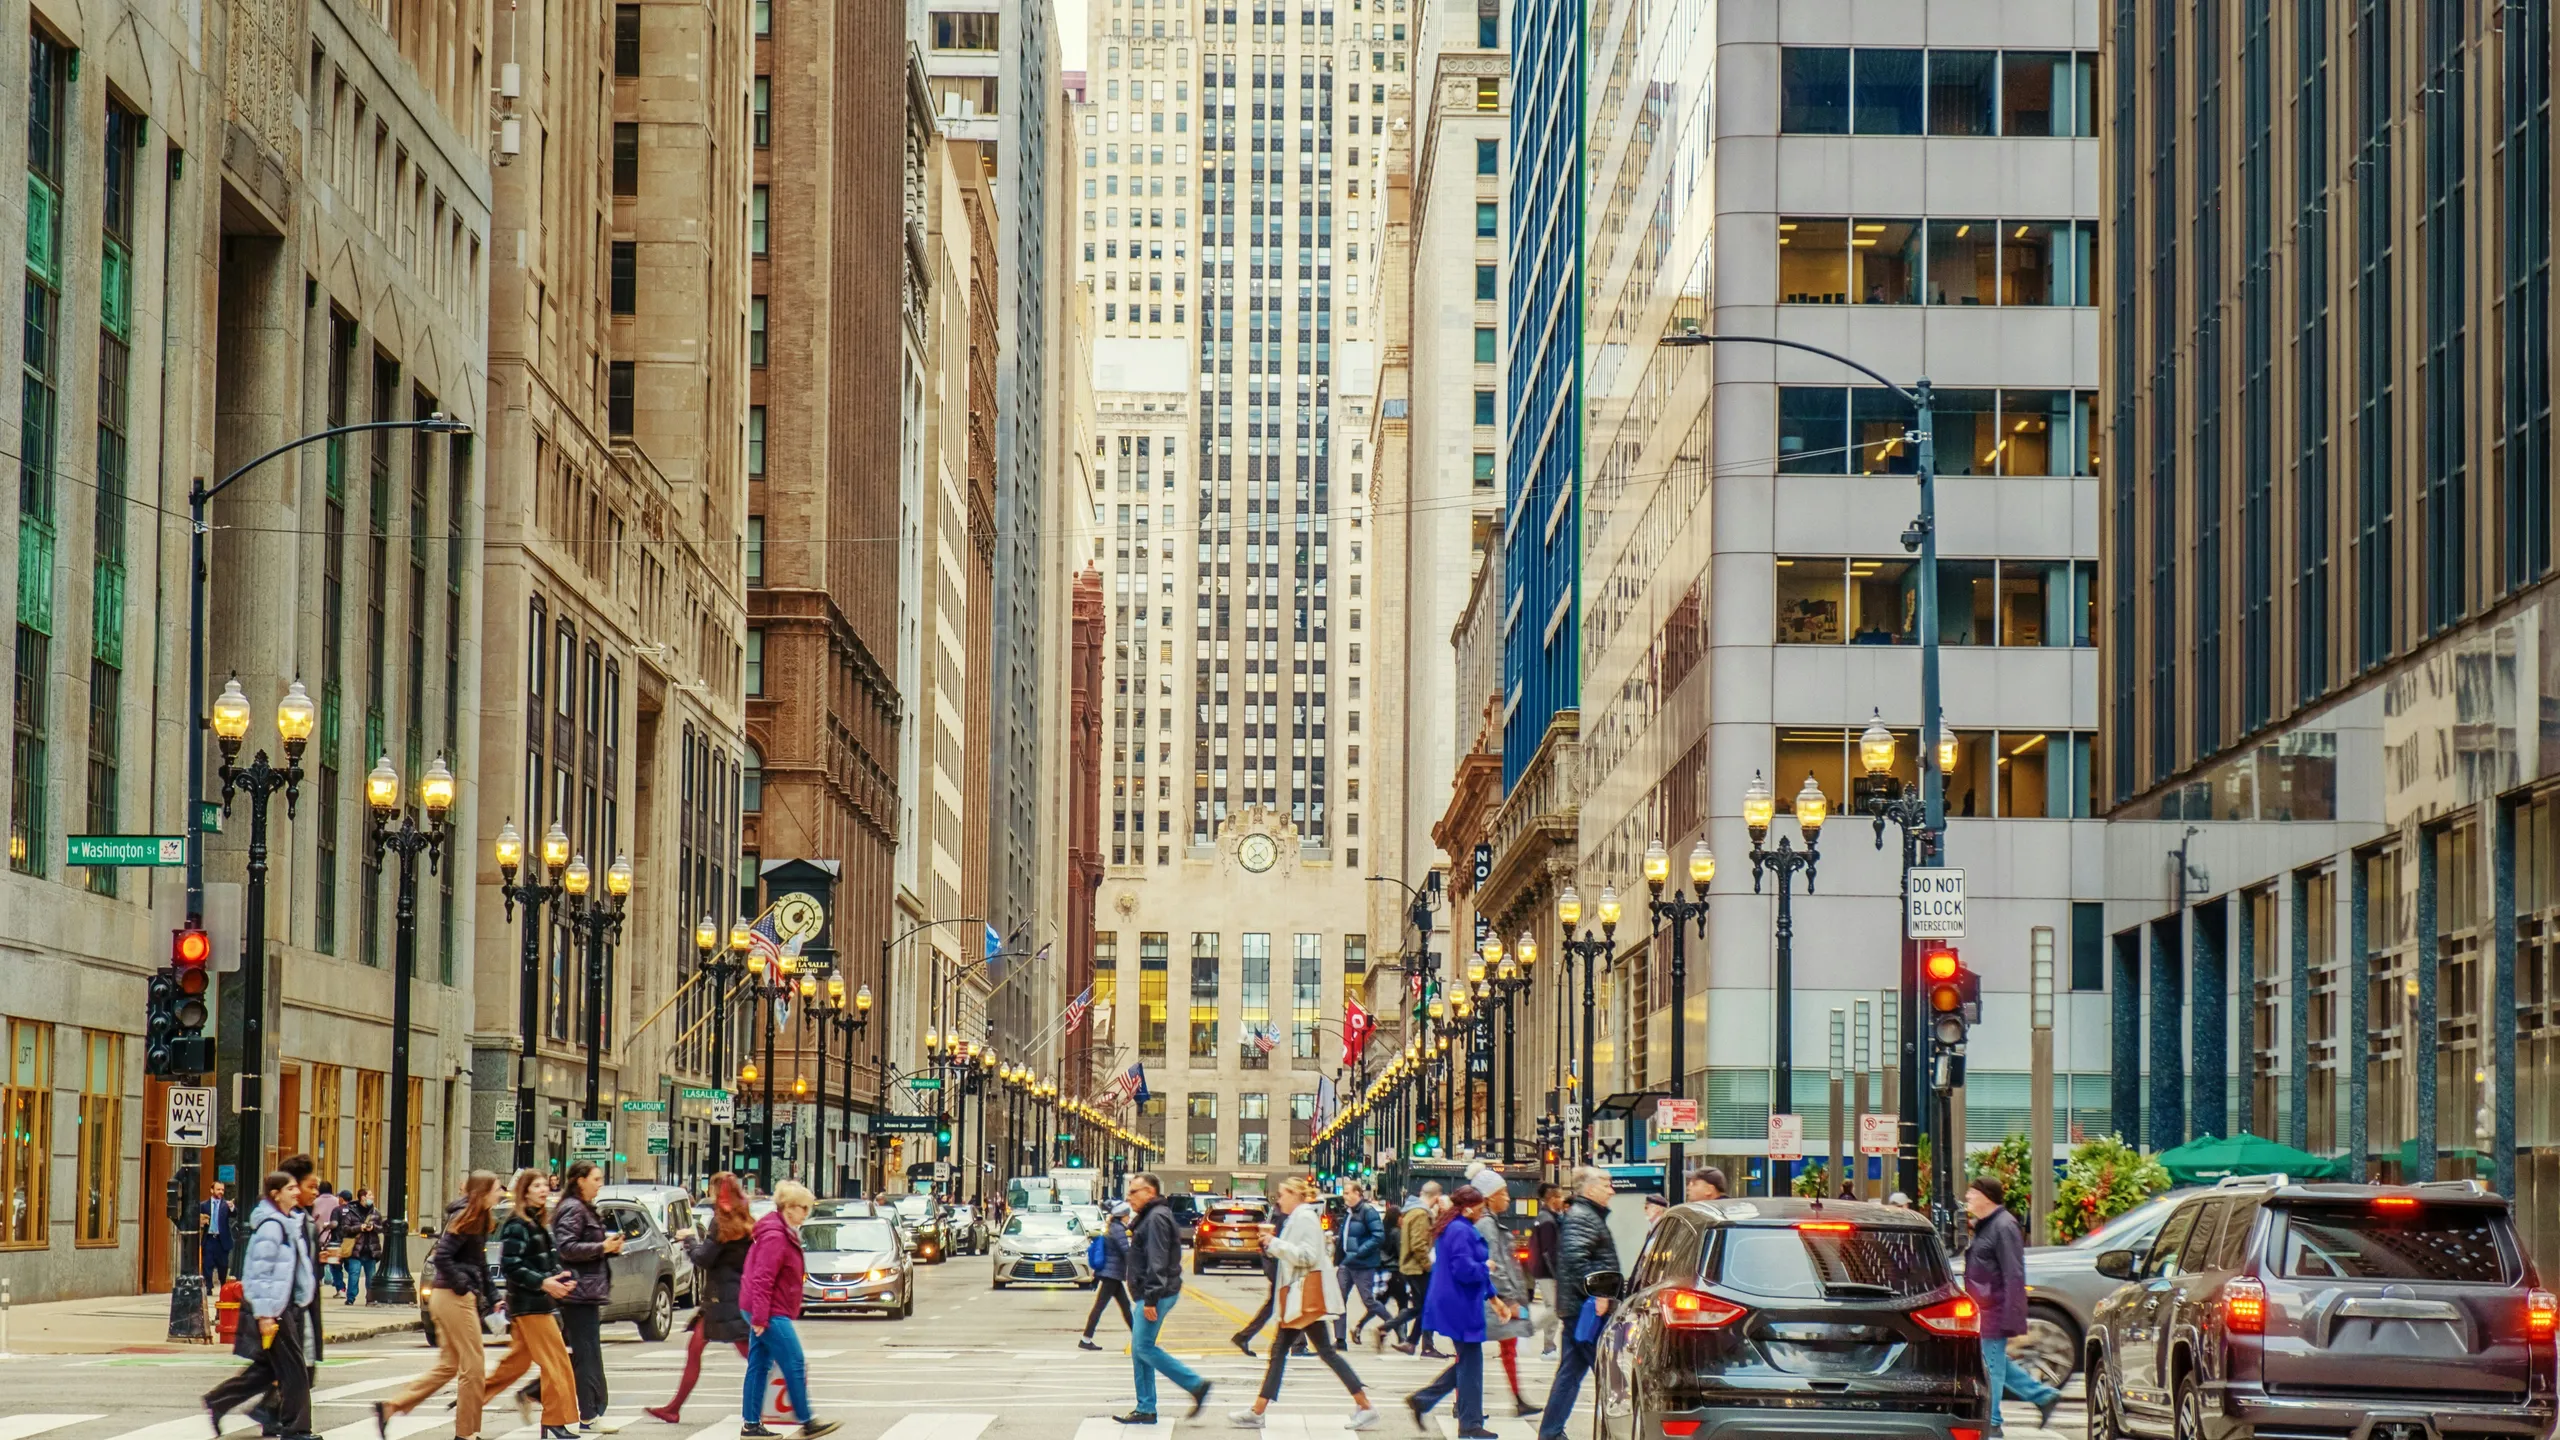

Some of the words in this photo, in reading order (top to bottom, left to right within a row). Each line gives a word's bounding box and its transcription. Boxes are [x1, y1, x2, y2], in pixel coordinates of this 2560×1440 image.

[81, 841, 144, 863] Washington
[146, 845, 156, 855] St
[1913, 878, 1932, 893] DO
[1935, 877, 1963, 893] NOT
[1913, 900, 1963, 916] BLOCK
[1912, 920, 1964, 932] INTERSECTION
[18, 1046, 33, 1065] LOFT
[174, 1092, 205, 1107] ONE
[685, 1089, 720, 1099] LASALLE
[627, 1101, 662, 1111] CALHOUN
[713, 1105, 731, 1113] WAY
[1568, 1106, 1581, 1115] ON
[171, 1108, 207, 1123] WAY
[1568, 1115, 1581, 1124] WA
